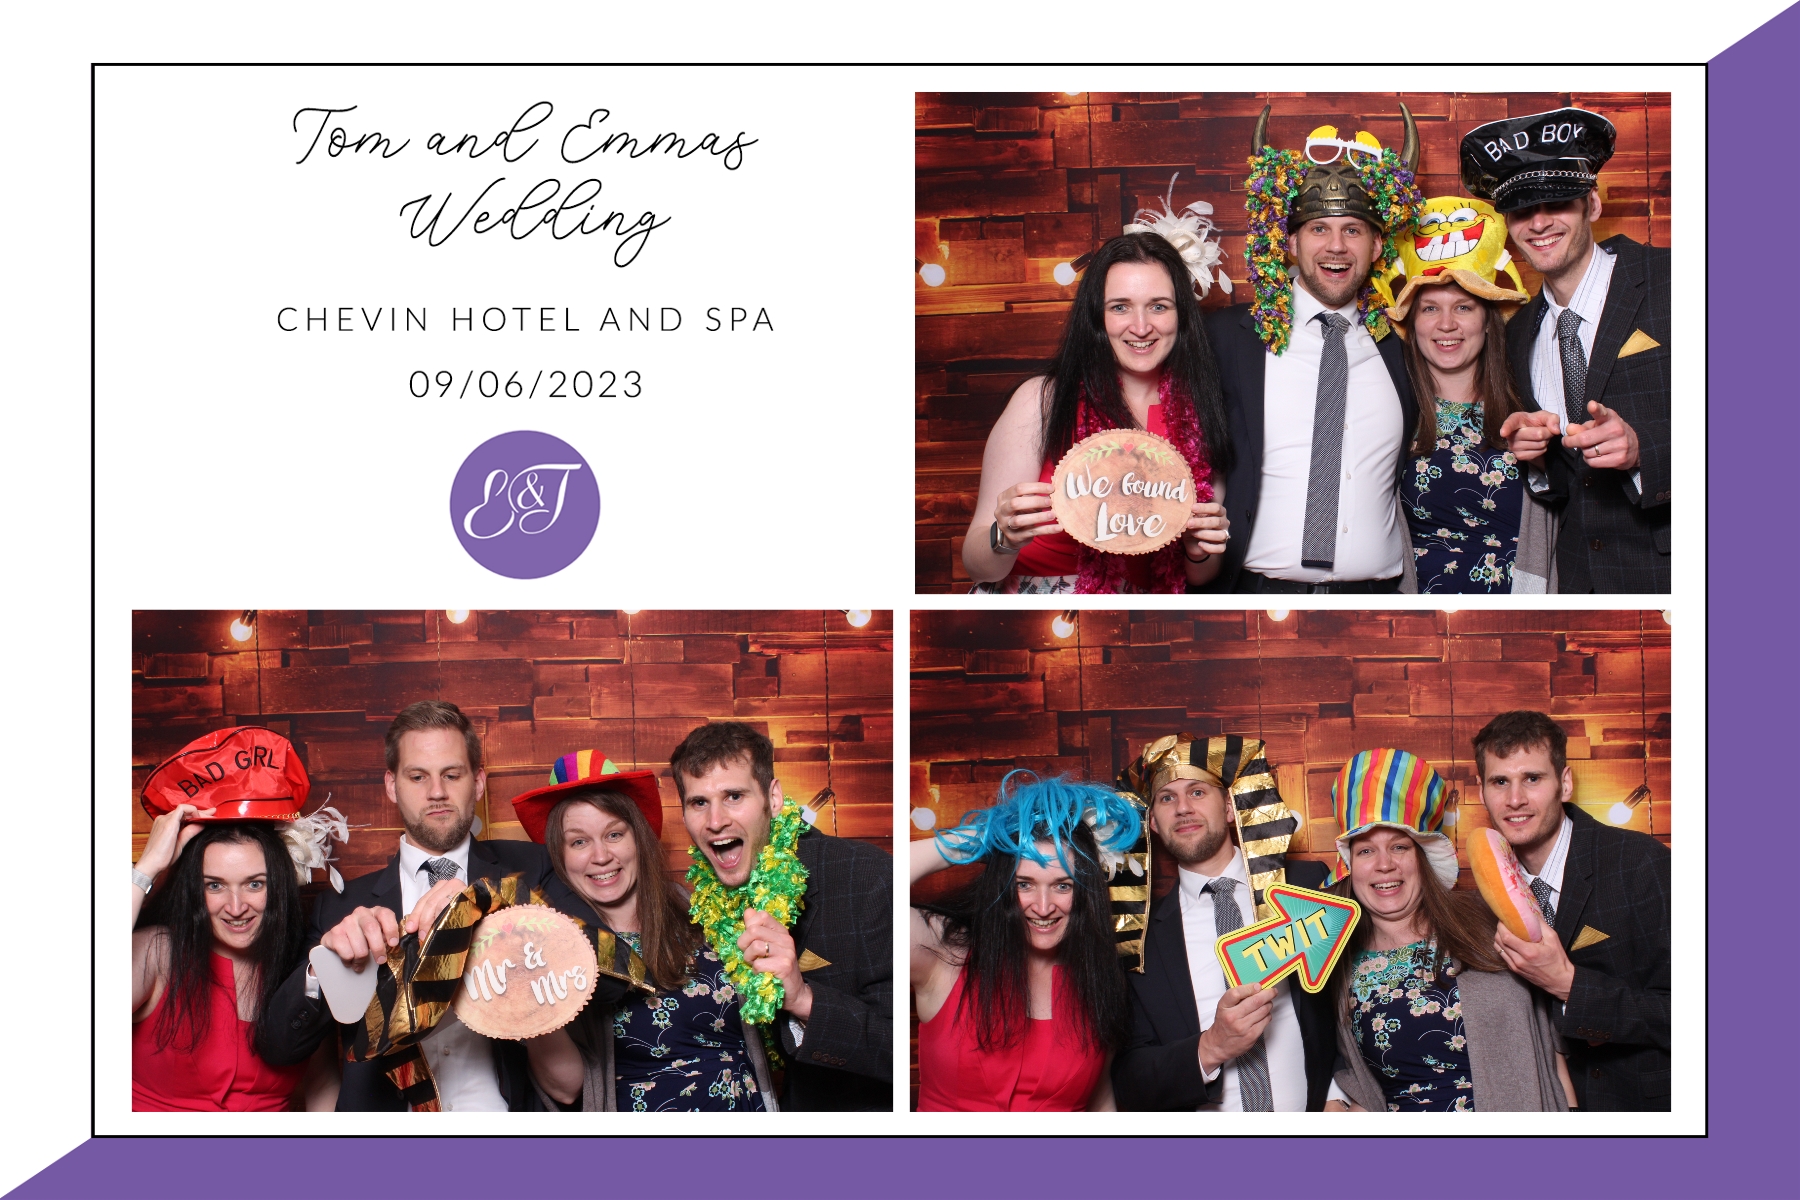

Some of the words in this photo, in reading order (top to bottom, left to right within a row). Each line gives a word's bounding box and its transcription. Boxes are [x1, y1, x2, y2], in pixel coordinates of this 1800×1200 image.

[1484, 131, 1529, 162] BAD
[1541, 123, 1584, 144] BOY
[1066, 464, 1113, 500] We
[1122, 472, 1188, 503] found
[1094, 502, 1167, 542] Love
[177, 761, 225, 799] BAD
[1241, 906, 1329, 972] TWIT
[463, 959, 516, 1001] Mr
[523, 941, 547, 970] &
[530, 966, 587, 1005] Mrs
